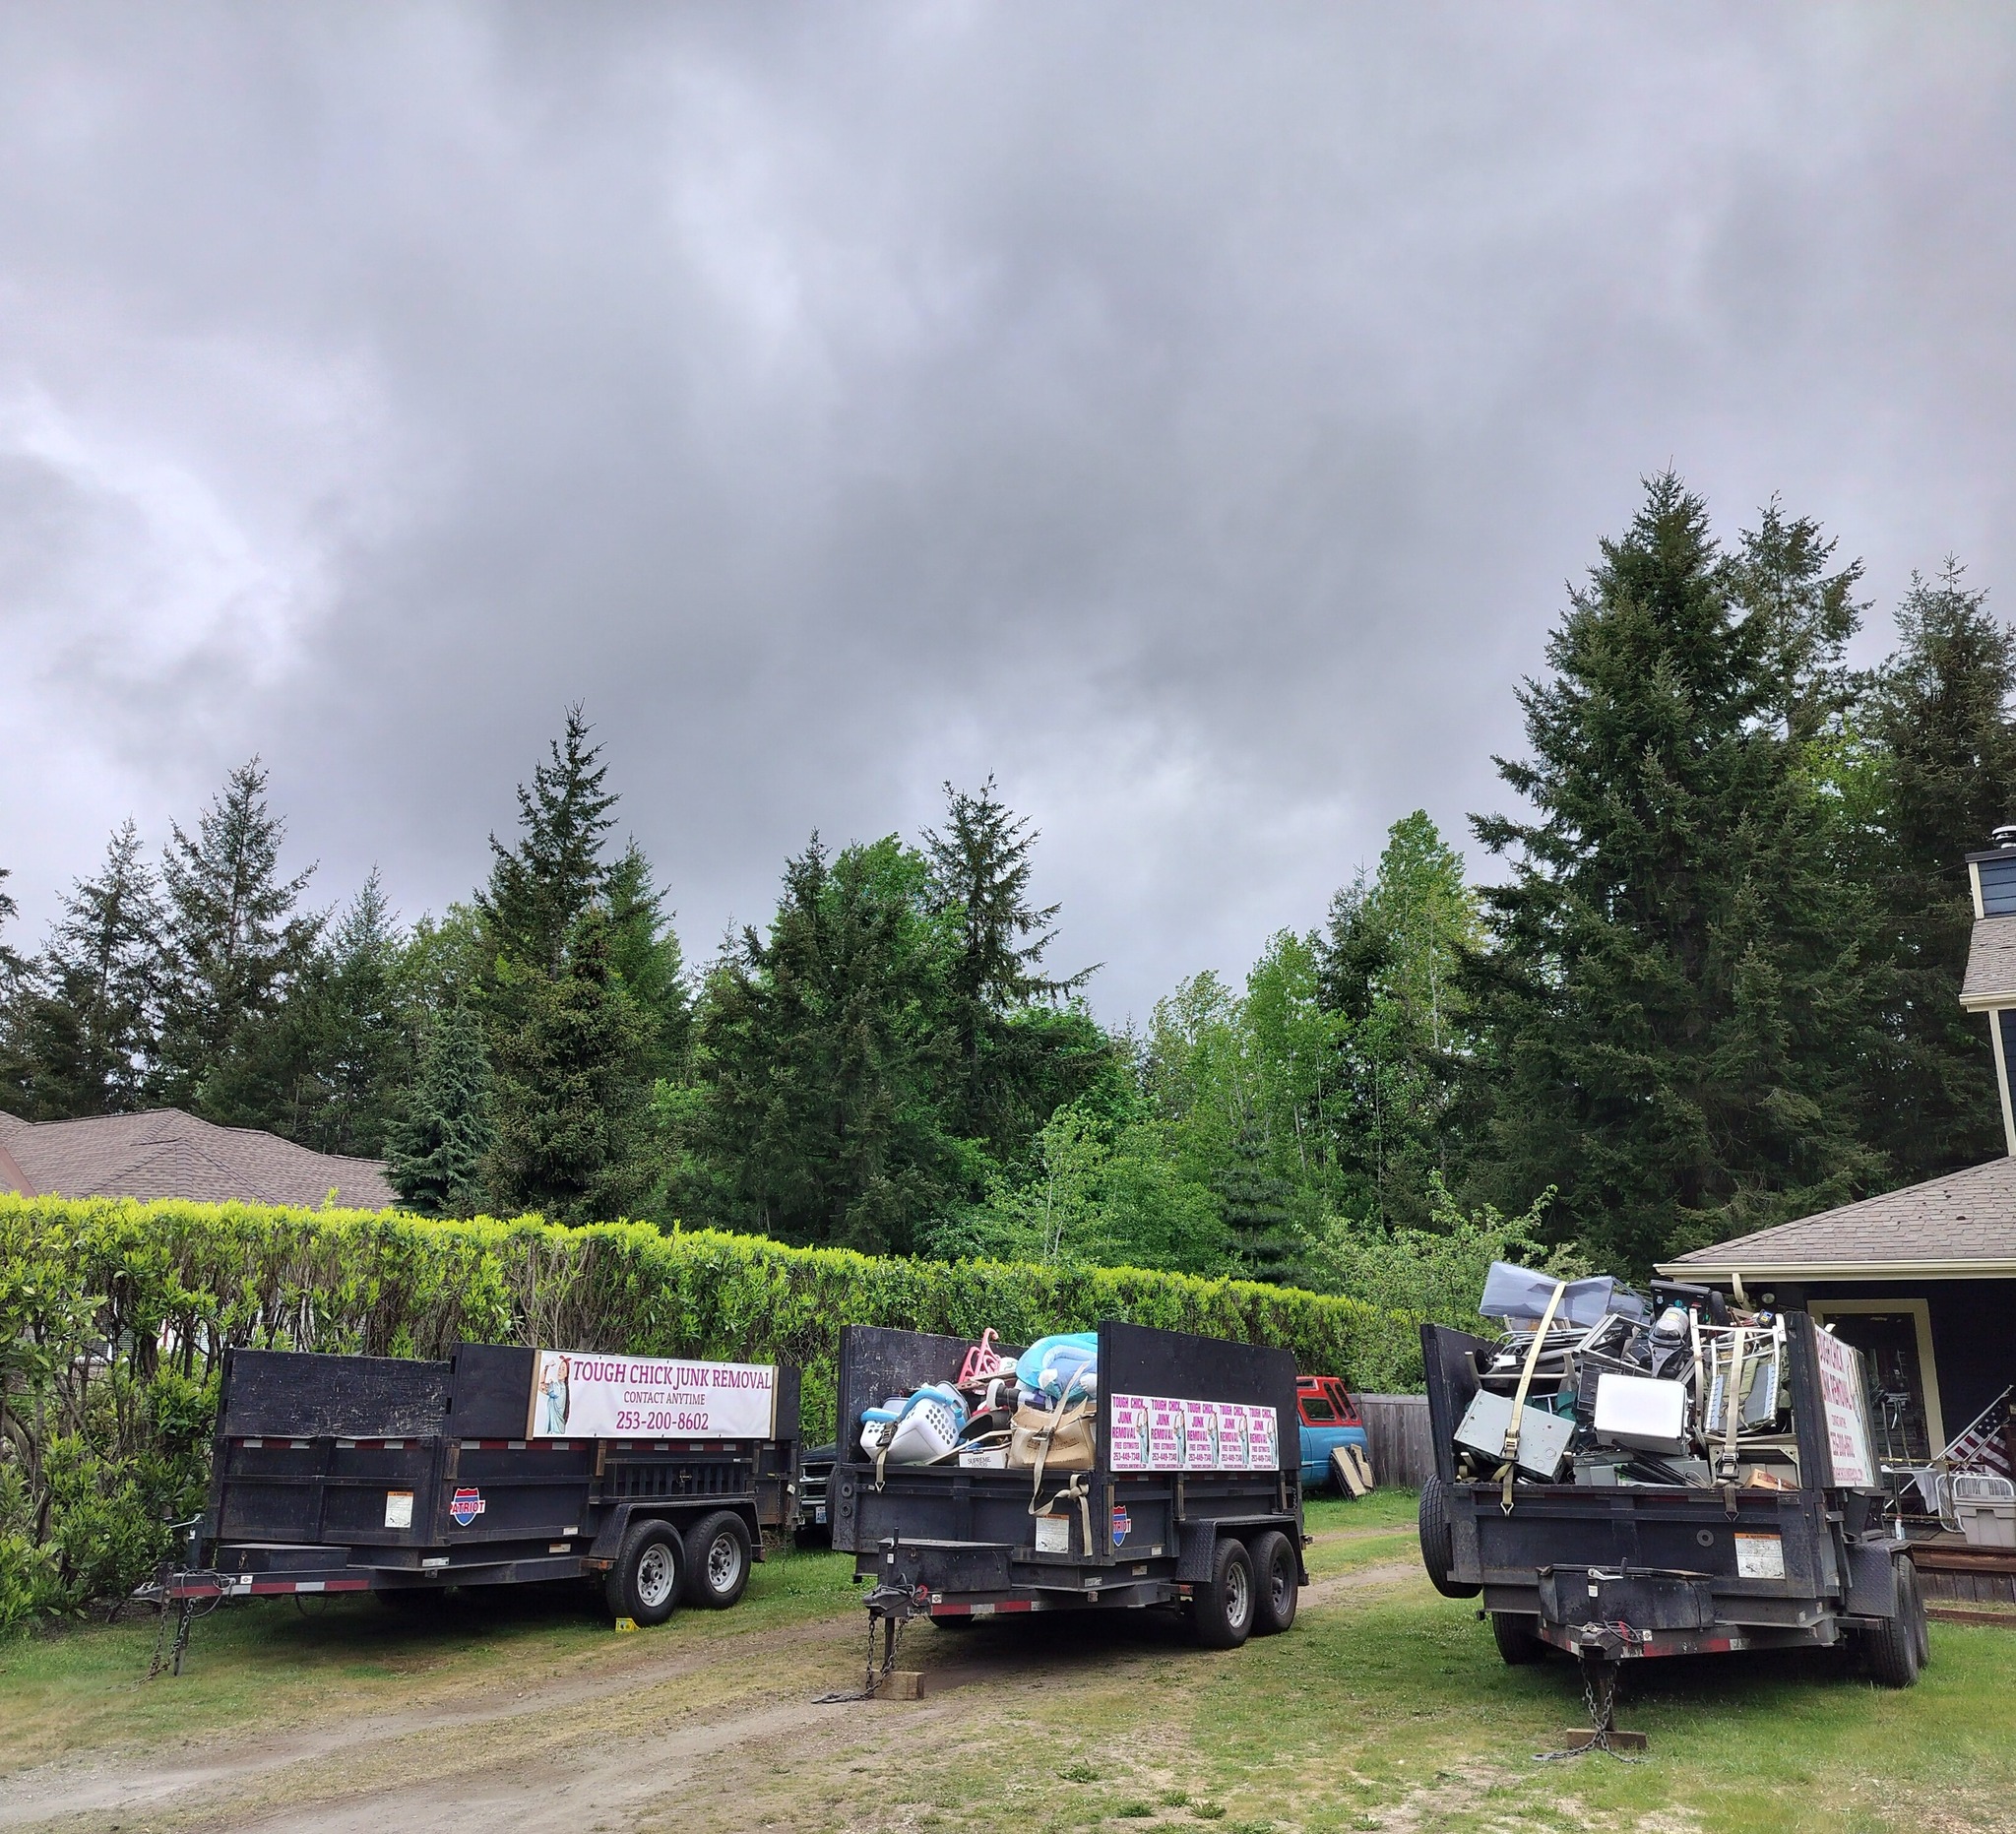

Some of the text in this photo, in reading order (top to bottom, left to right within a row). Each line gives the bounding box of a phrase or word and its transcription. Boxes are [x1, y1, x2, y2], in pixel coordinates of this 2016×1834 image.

[574, 1360, 772, 1390] TOUGH CHICK JUNK REMOVAL
[623, 1390, 706, 1406] CONTACT ANYTIME
[1112, 1396, 1129, 1408] TOUGH
[1151, 1399, 1167, 1411] TOUGH
[616, 1411, 709, 1430] 253-200-8602
[1117, 1412, 1132, 1423] JUNK
[1156, 1414, 1170, 1425] JUNK
[1192, 1416, 1204, 1427] JUNK
[1112, 1426, 1136, 1439] REMOVAL
[1151, 1428, 1173, 1440] REMOVAL
[1187, 1430, 1208, 1441] REMOVAL
[1113, 1520, 1131, 1532] TRIOT
